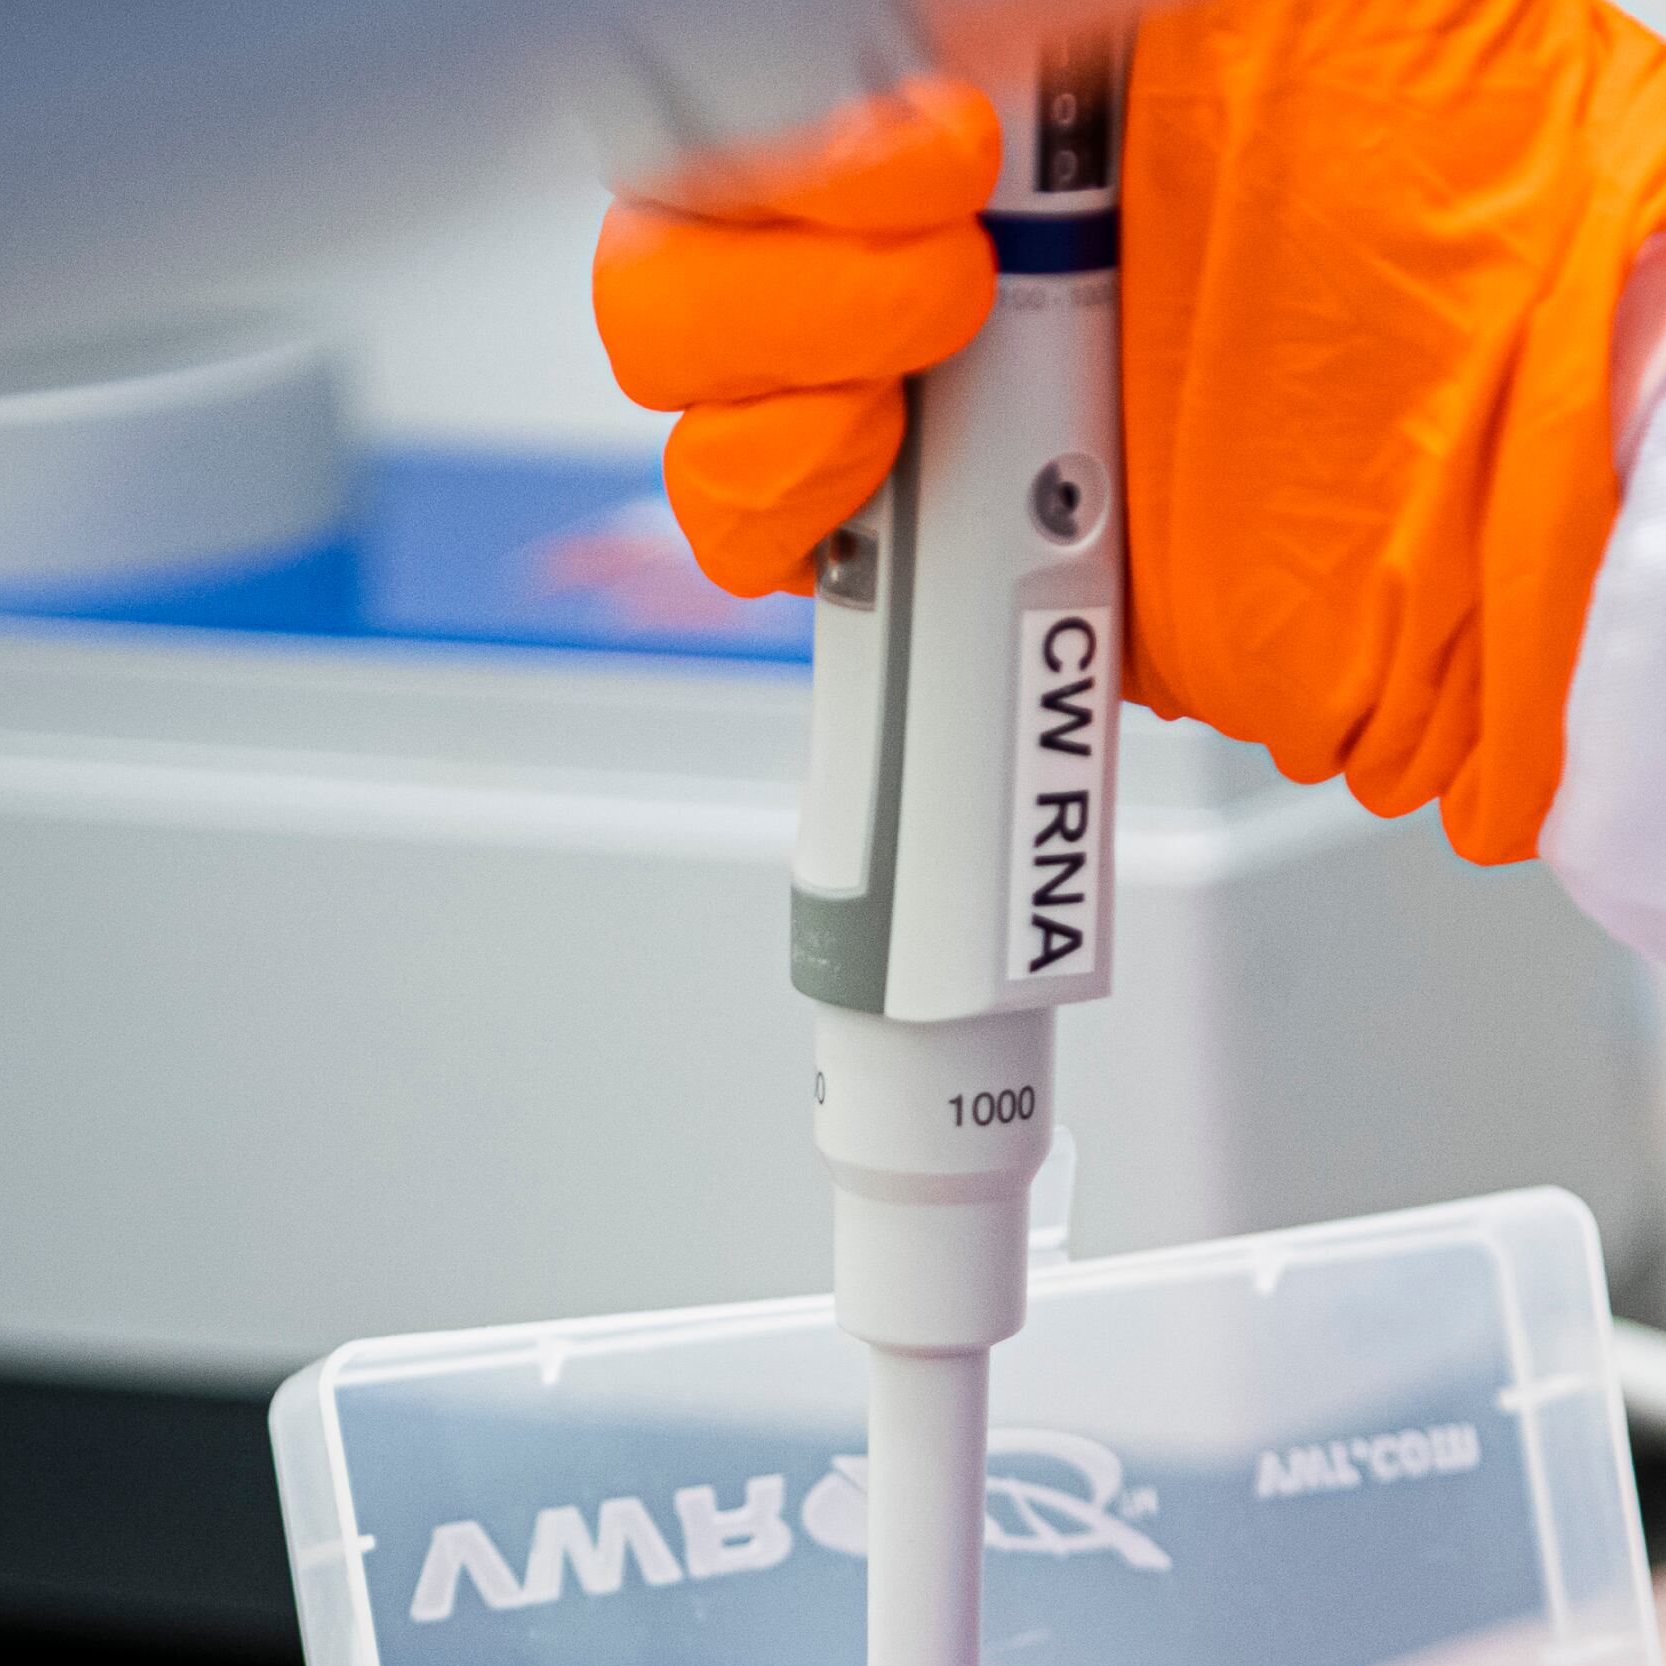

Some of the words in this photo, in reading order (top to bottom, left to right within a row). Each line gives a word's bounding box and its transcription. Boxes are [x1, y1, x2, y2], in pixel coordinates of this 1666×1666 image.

[1039, 616, 1098, 757] CW
[1028, 790, 1091, 974] RNA
[948, 1084, 1036, 1127] 1000
